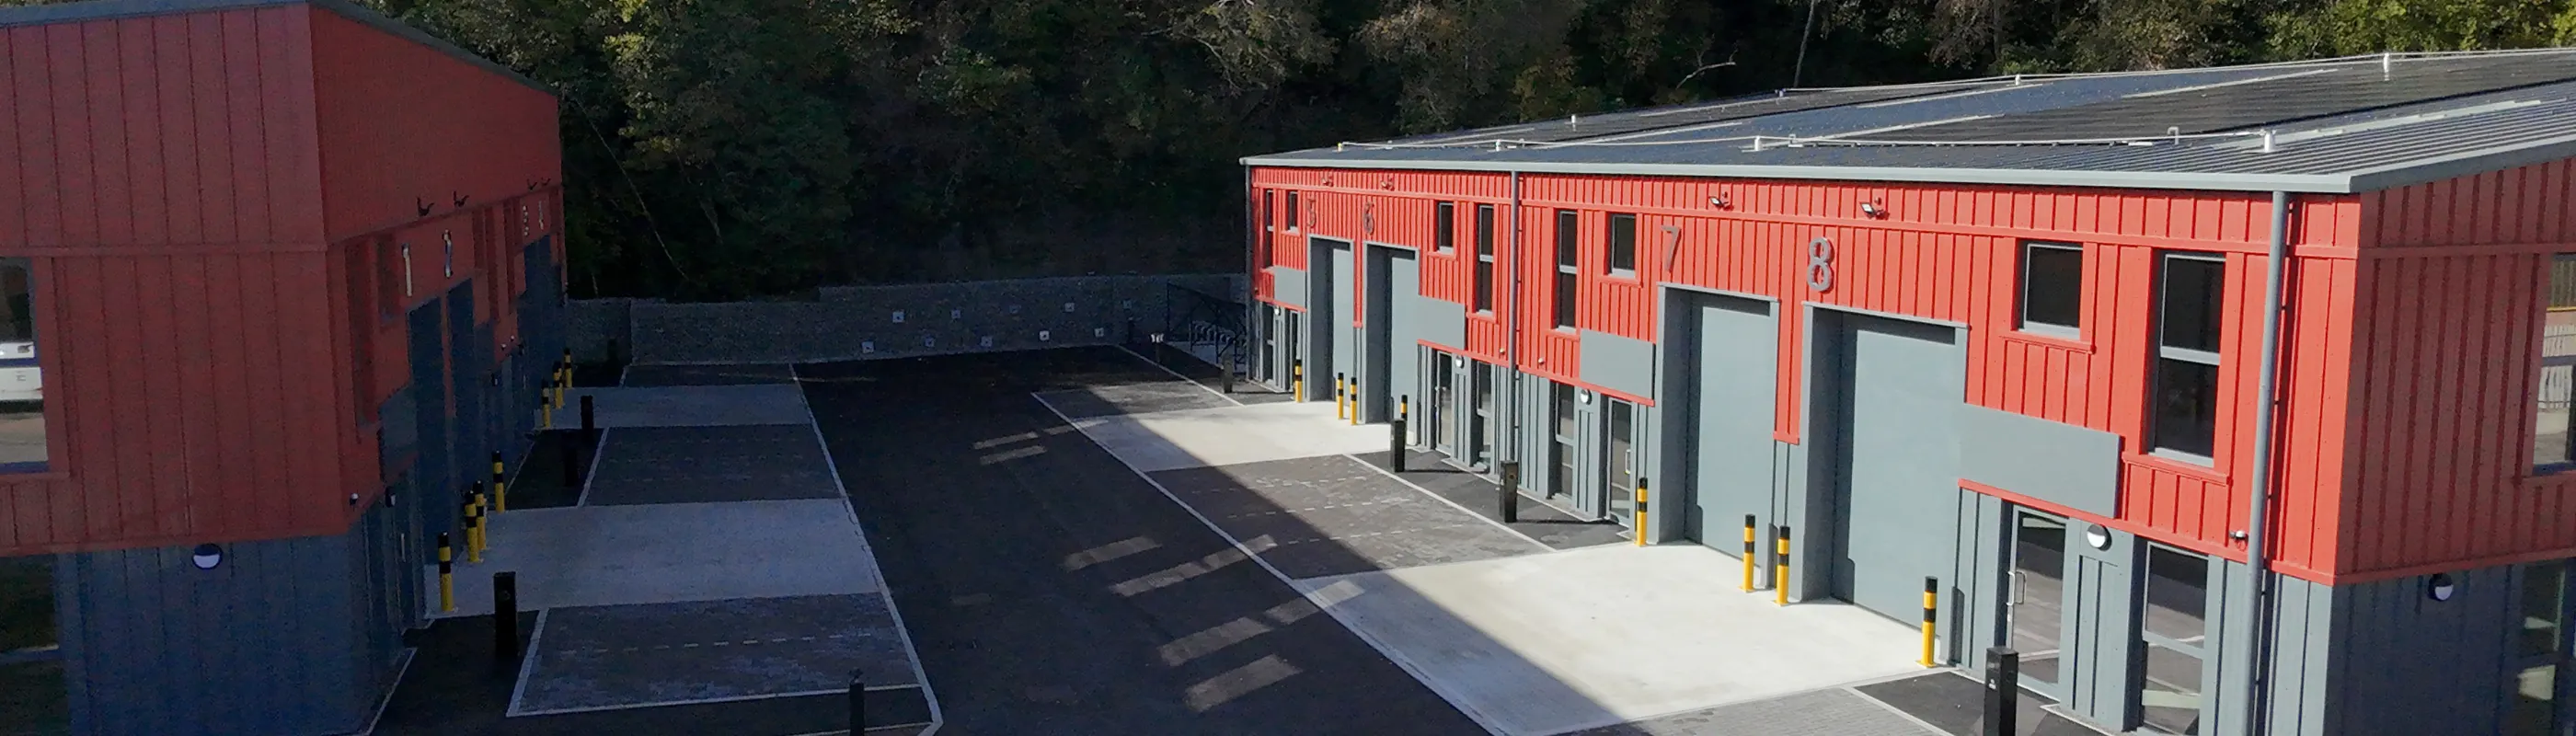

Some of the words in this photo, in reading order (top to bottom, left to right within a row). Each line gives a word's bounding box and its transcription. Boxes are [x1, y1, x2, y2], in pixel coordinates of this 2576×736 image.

[1364, 201, 1375, 236] 6
[1661, 224, 1682, 272] 7
[1806, 236, 1834, 293] 8
